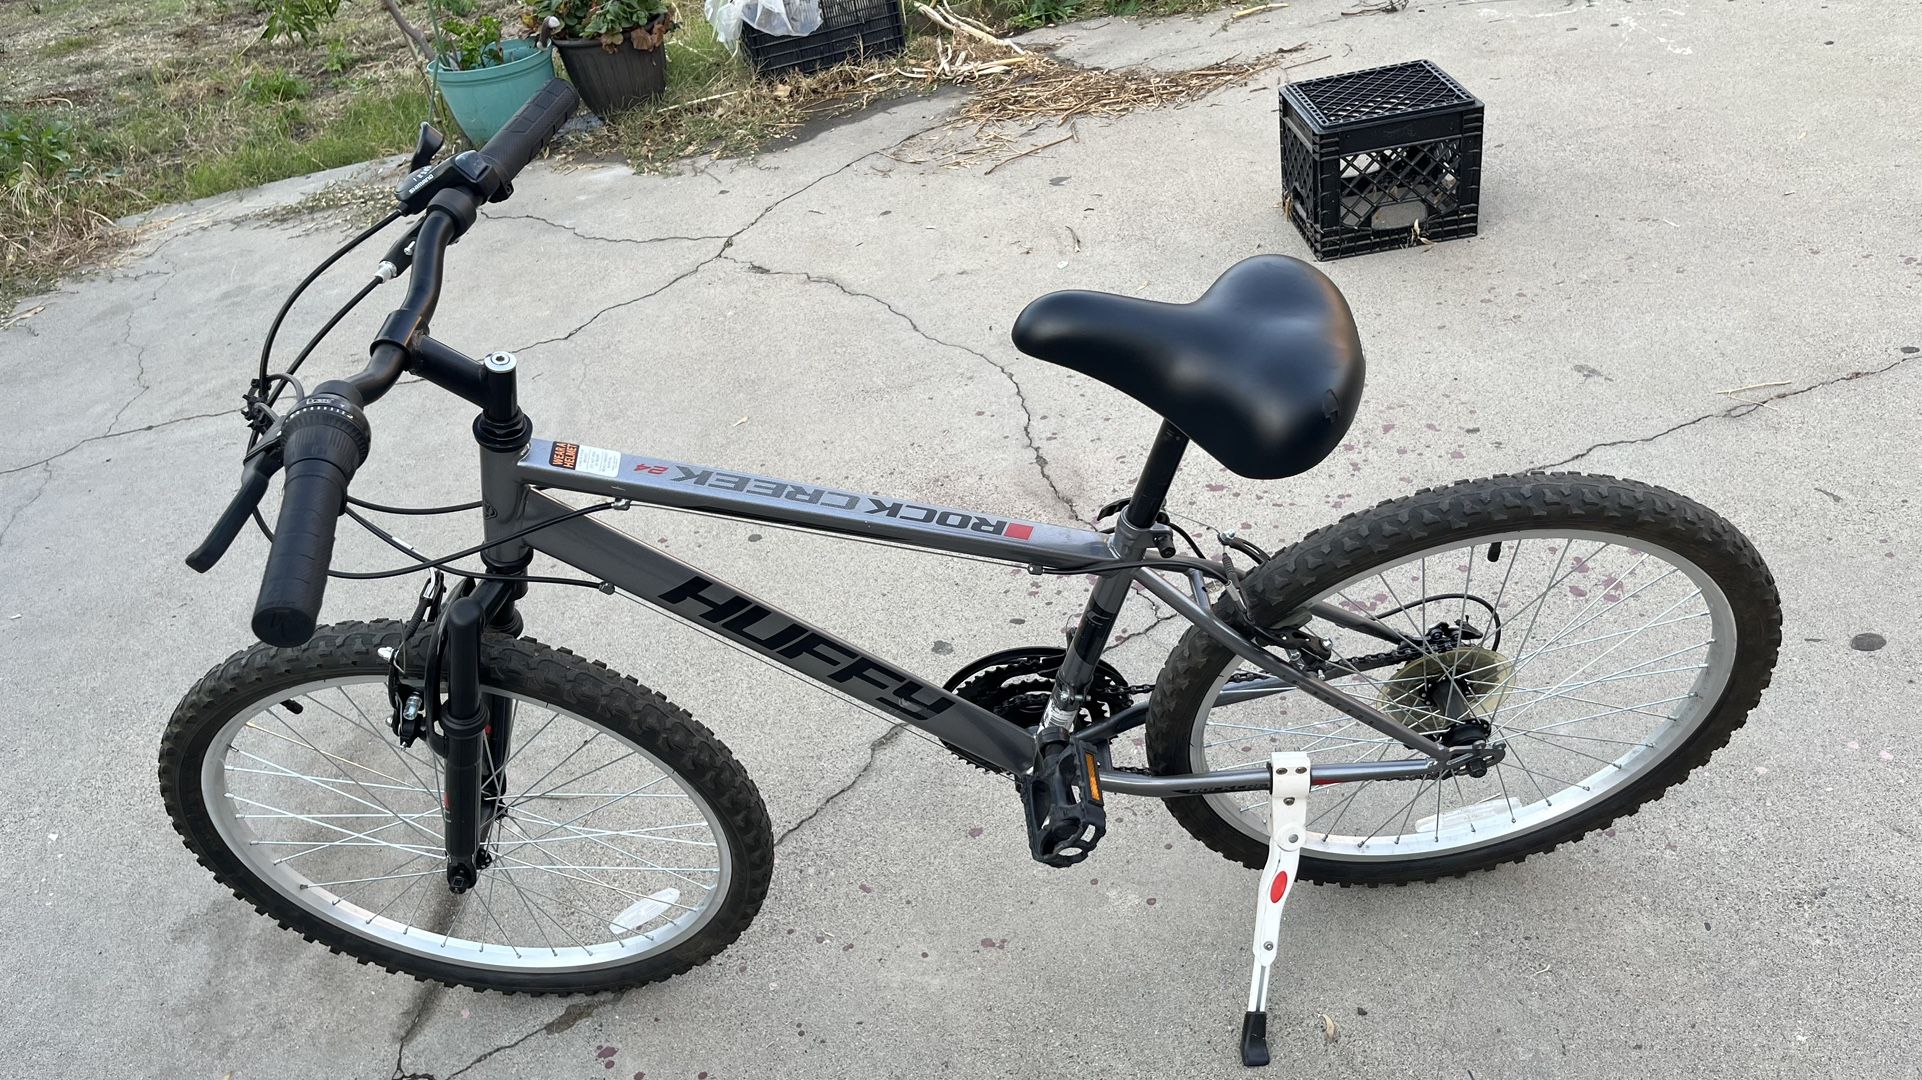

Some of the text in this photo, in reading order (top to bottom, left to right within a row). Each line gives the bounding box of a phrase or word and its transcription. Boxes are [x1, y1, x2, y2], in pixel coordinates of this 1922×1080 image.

[553, 447, 567, 465] WEAR
[563, 443, 578, 469] HELMET
[634, 464, 1008, 536] ROCK CREEK 24
[657, 576, 956, 720] HUFFY
